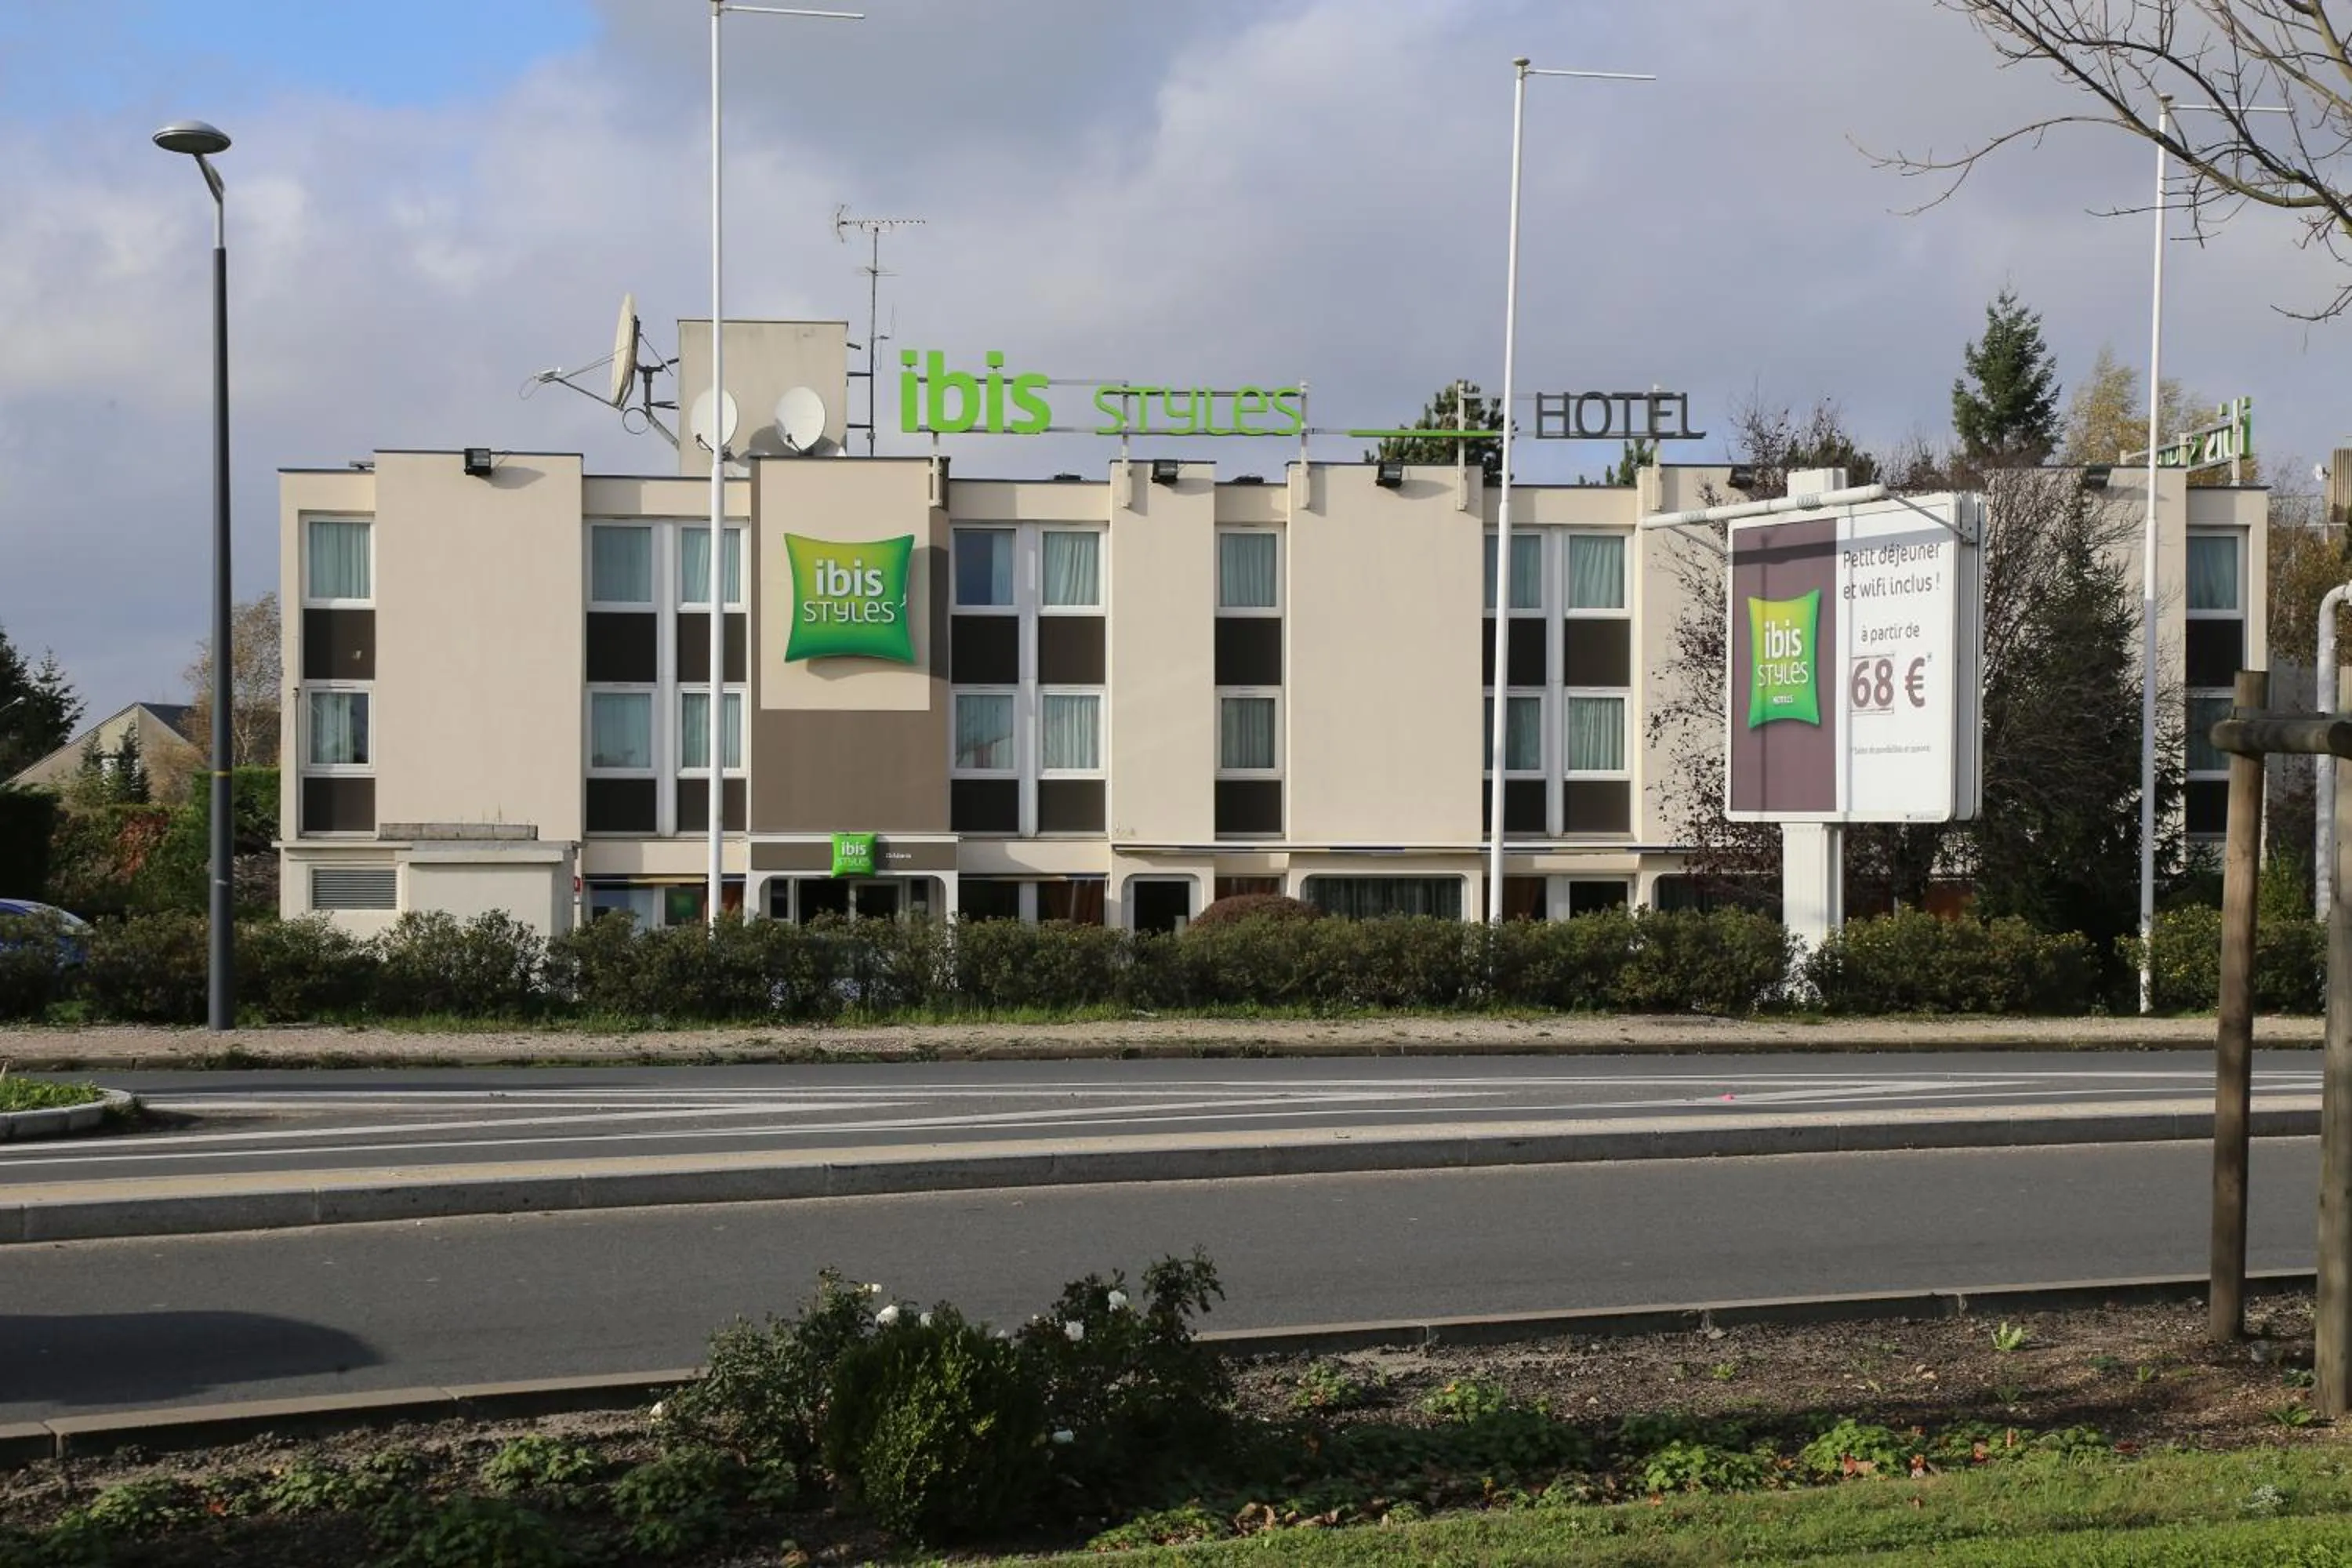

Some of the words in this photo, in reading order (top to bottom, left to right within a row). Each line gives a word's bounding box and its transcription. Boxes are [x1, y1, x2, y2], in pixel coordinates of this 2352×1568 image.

[901, 350, 1051, 434] ibis
[1535, 391, 1707, 439] HOTEL
[1843, 548, 1875, 570] Petit
[1878, 543, 1940, 568] déjeuner
[816, 558, 884, 597] ibis
[1843, 583, 1857, 599] et
[1860, 576, 1886, 597] wifi
[1890, 572, 1933, 596] inclus
[1765, 619, 1802, 659] ibis
[1860, 624, 1867, 642] à
[1871, 623, 1903, 646] partir
[1905, 622, 1920, 637] de
[1852, 658, 1894, 708] 68
[840, 840, 866, 855] ibis
